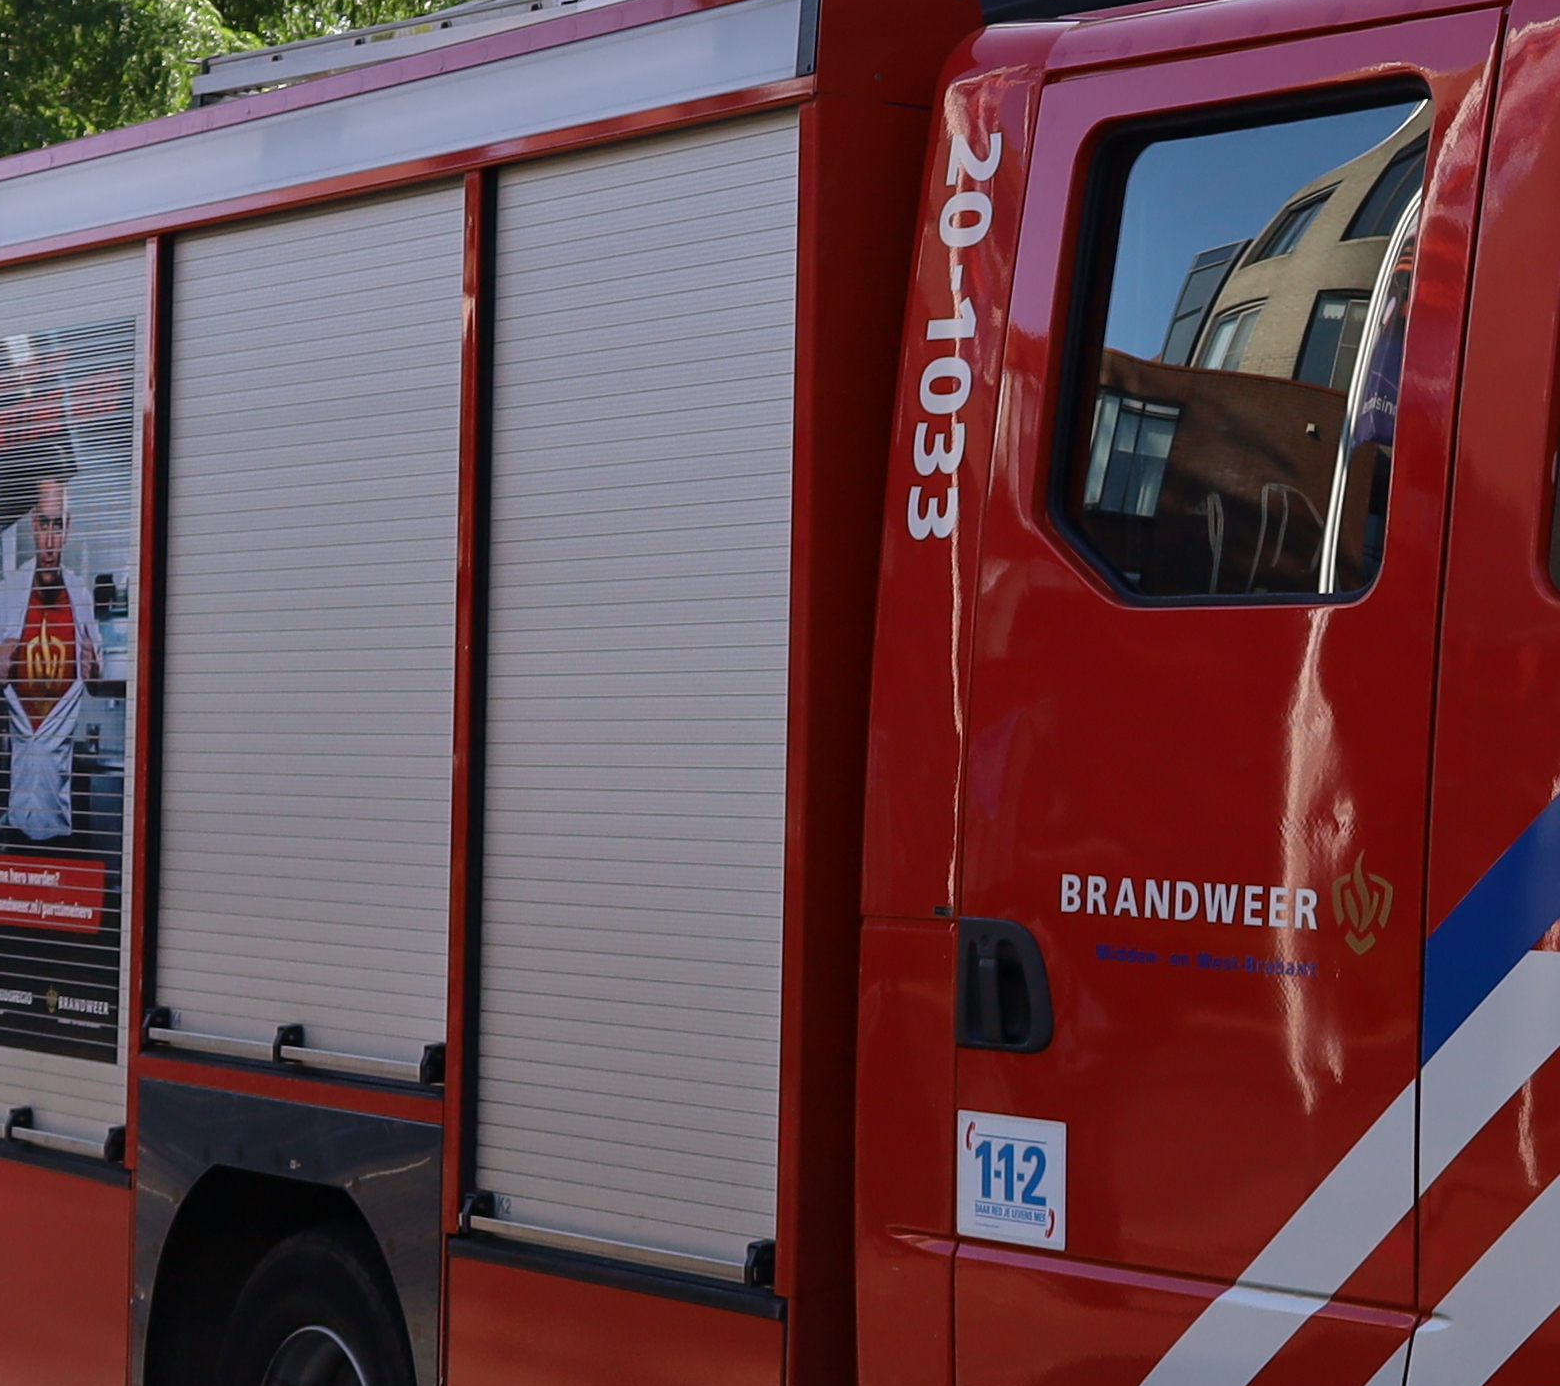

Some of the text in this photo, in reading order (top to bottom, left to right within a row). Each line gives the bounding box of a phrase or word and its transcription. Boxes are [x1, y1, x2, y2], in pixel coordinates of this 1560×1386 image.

[907, 132, 1003, 540] 20-1033
[1061, 874, 1318, 930] BRANDWEER
[58, 996, 110, 1015] BRANDWEER
